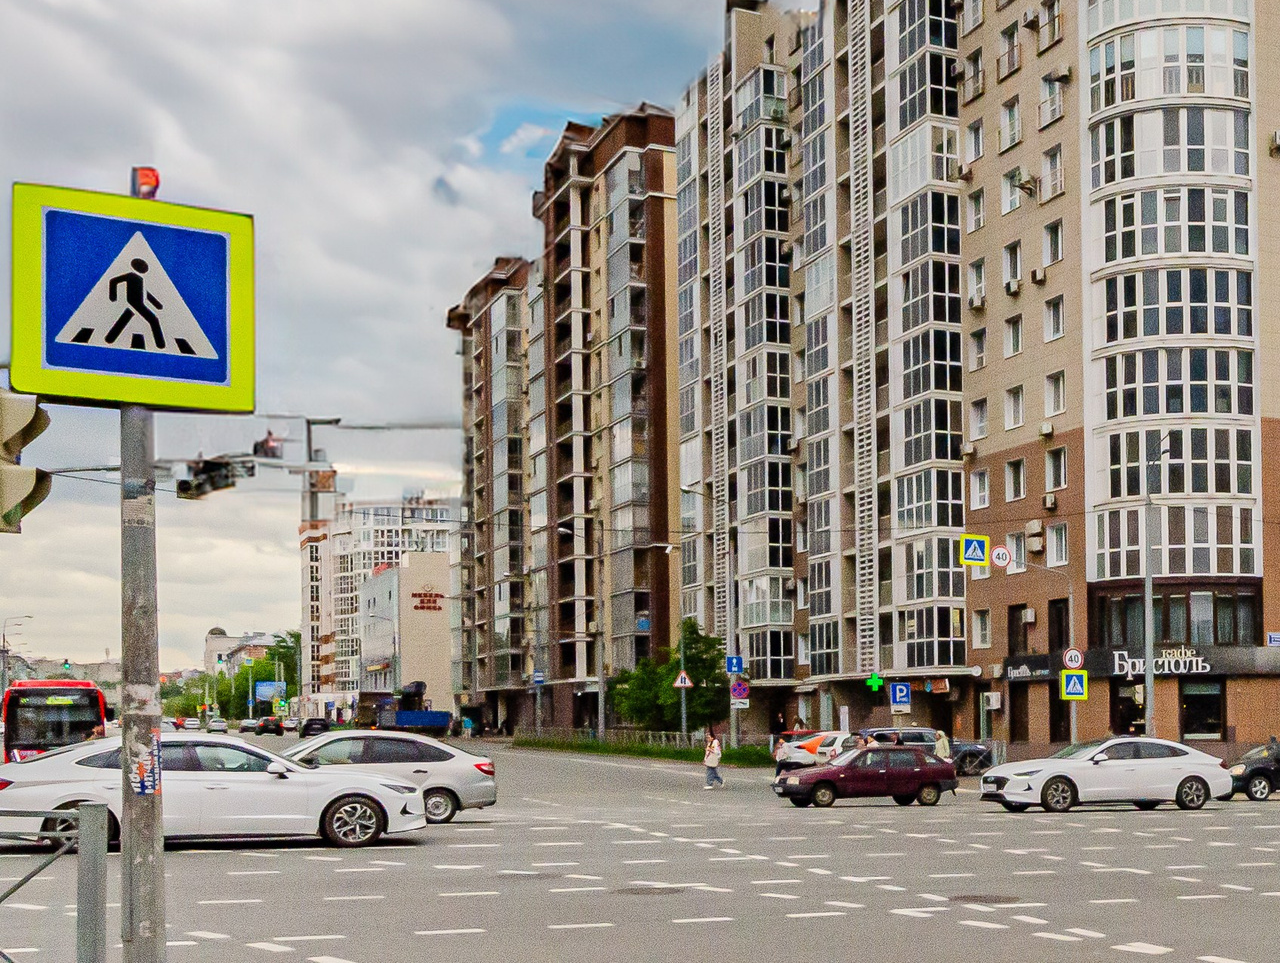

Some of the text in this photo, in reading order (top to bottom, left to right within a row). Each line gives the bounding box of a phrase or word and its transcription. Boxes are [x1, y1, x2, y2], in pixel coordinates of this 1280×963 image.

[995, 552, 1008, 562] 40
[1161, 645, 1196, 660] кафе
[1068, 654, 1080, 664] 40
